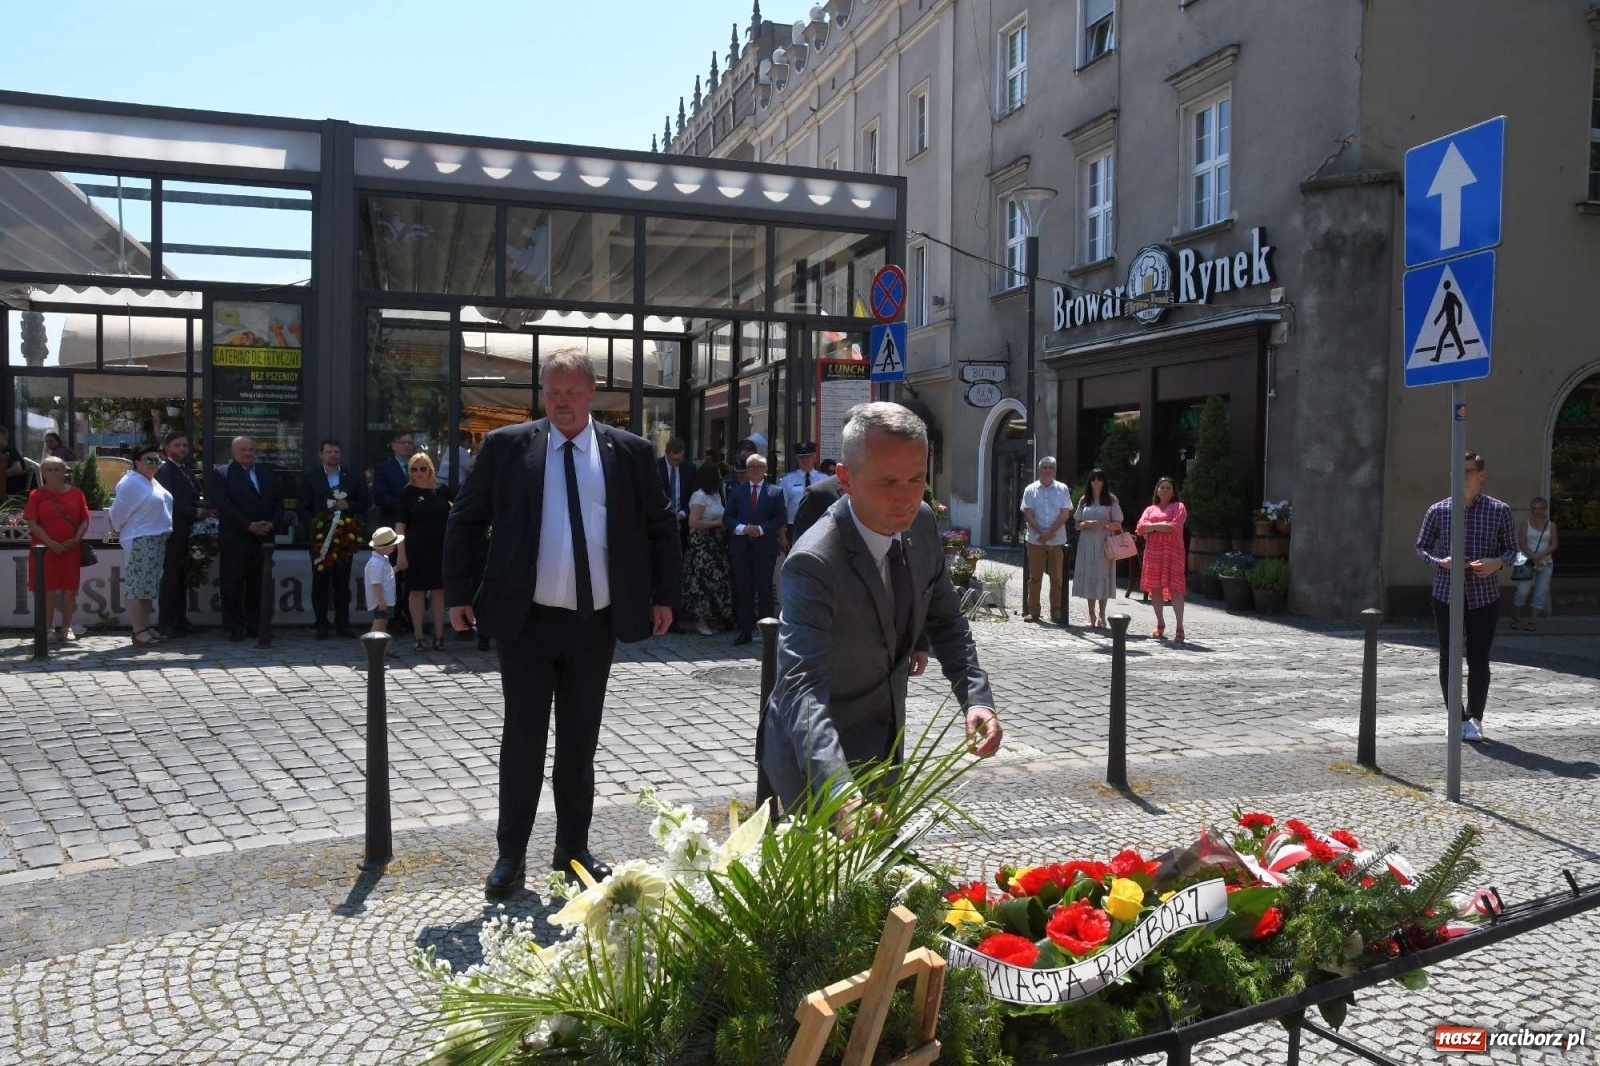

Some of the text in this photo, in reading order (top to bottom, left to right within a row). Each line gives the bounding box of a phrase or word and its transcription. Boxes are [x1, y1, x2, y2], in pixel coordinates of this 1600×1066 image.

[1052, 226, 1271, 332] Browar Rynek
[214, 348, 300, 366] CATERING DIETETYCZNY
[250, 371, 264, 381] BEZ
[828, 363, 866, 375] LUNCH
[985, 957, 1088, 1003] MIASTA
